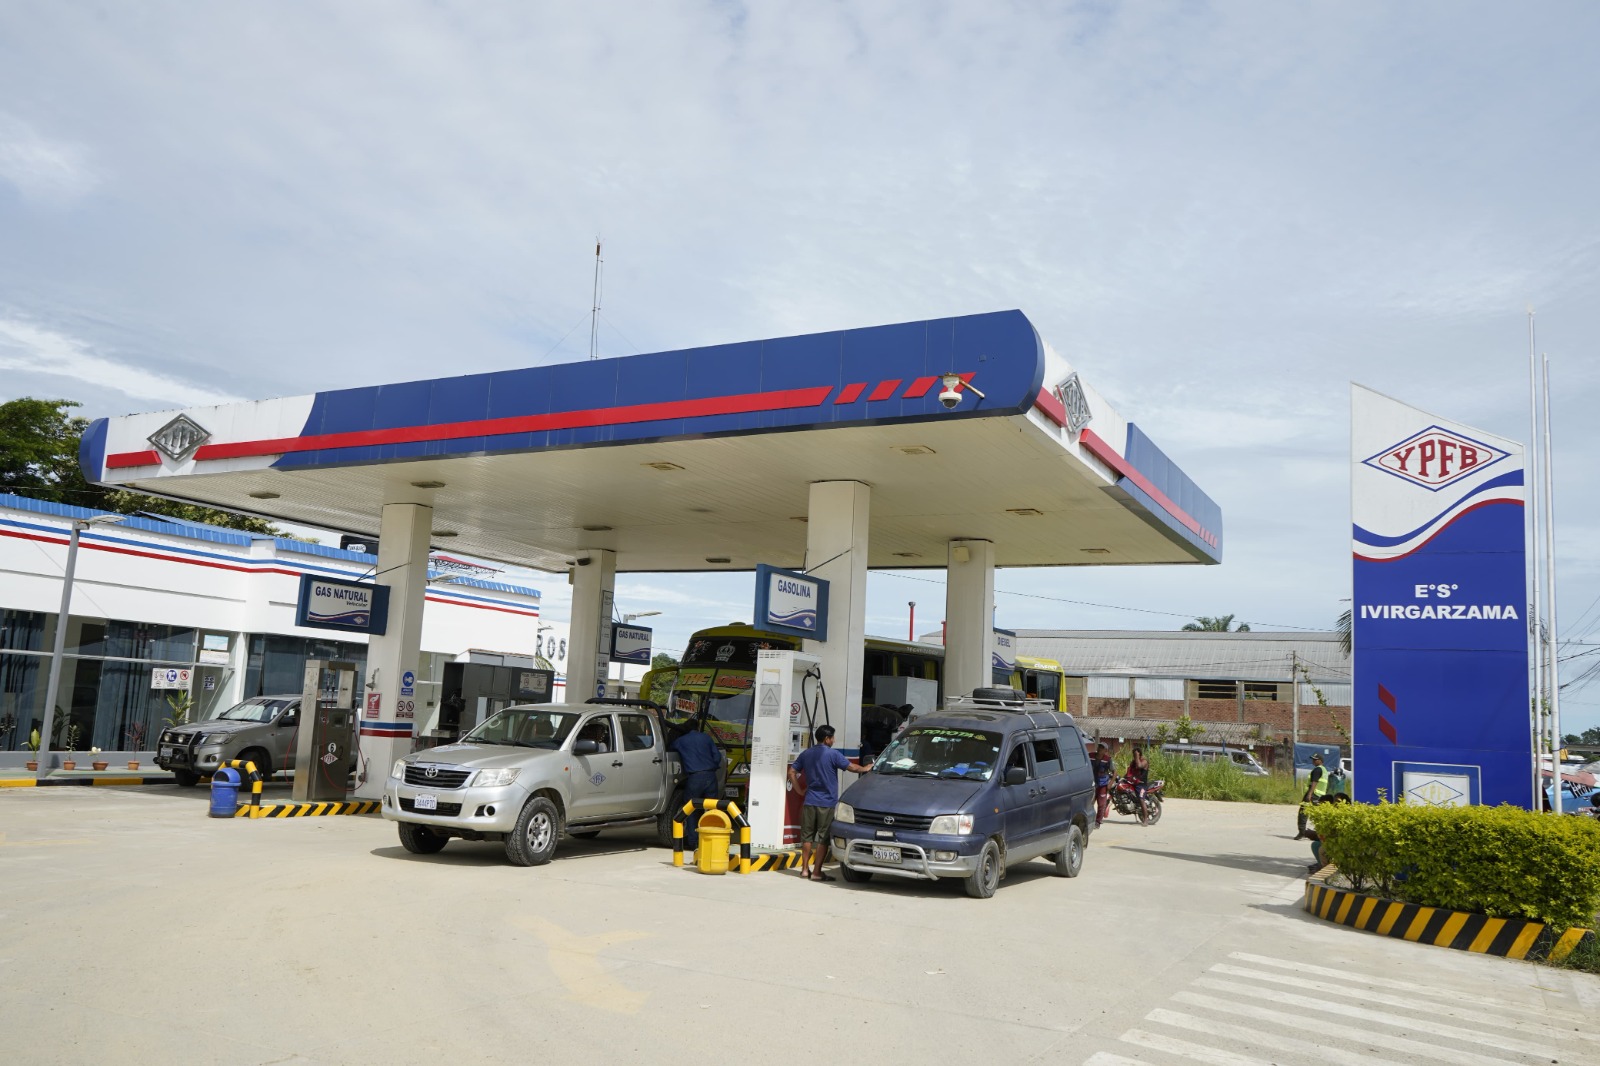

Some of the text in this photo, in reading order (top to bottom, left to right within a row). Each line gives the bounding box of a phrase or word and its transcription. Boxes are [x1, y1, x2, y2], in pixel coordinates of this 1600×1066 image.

[1393, 439, 1478, 478] YPFB
[315, 586, 368, 603] GAS NATURAL
[777, 579, 811, 599] GASOLINA
[1361, 605, 1519, 620] IVIRGARZAMA
[618, 630, 650, 642] GAS NATURAL
[682, 673, 712, 686] THE
[922, 729, 974, 738] TOYOTA
